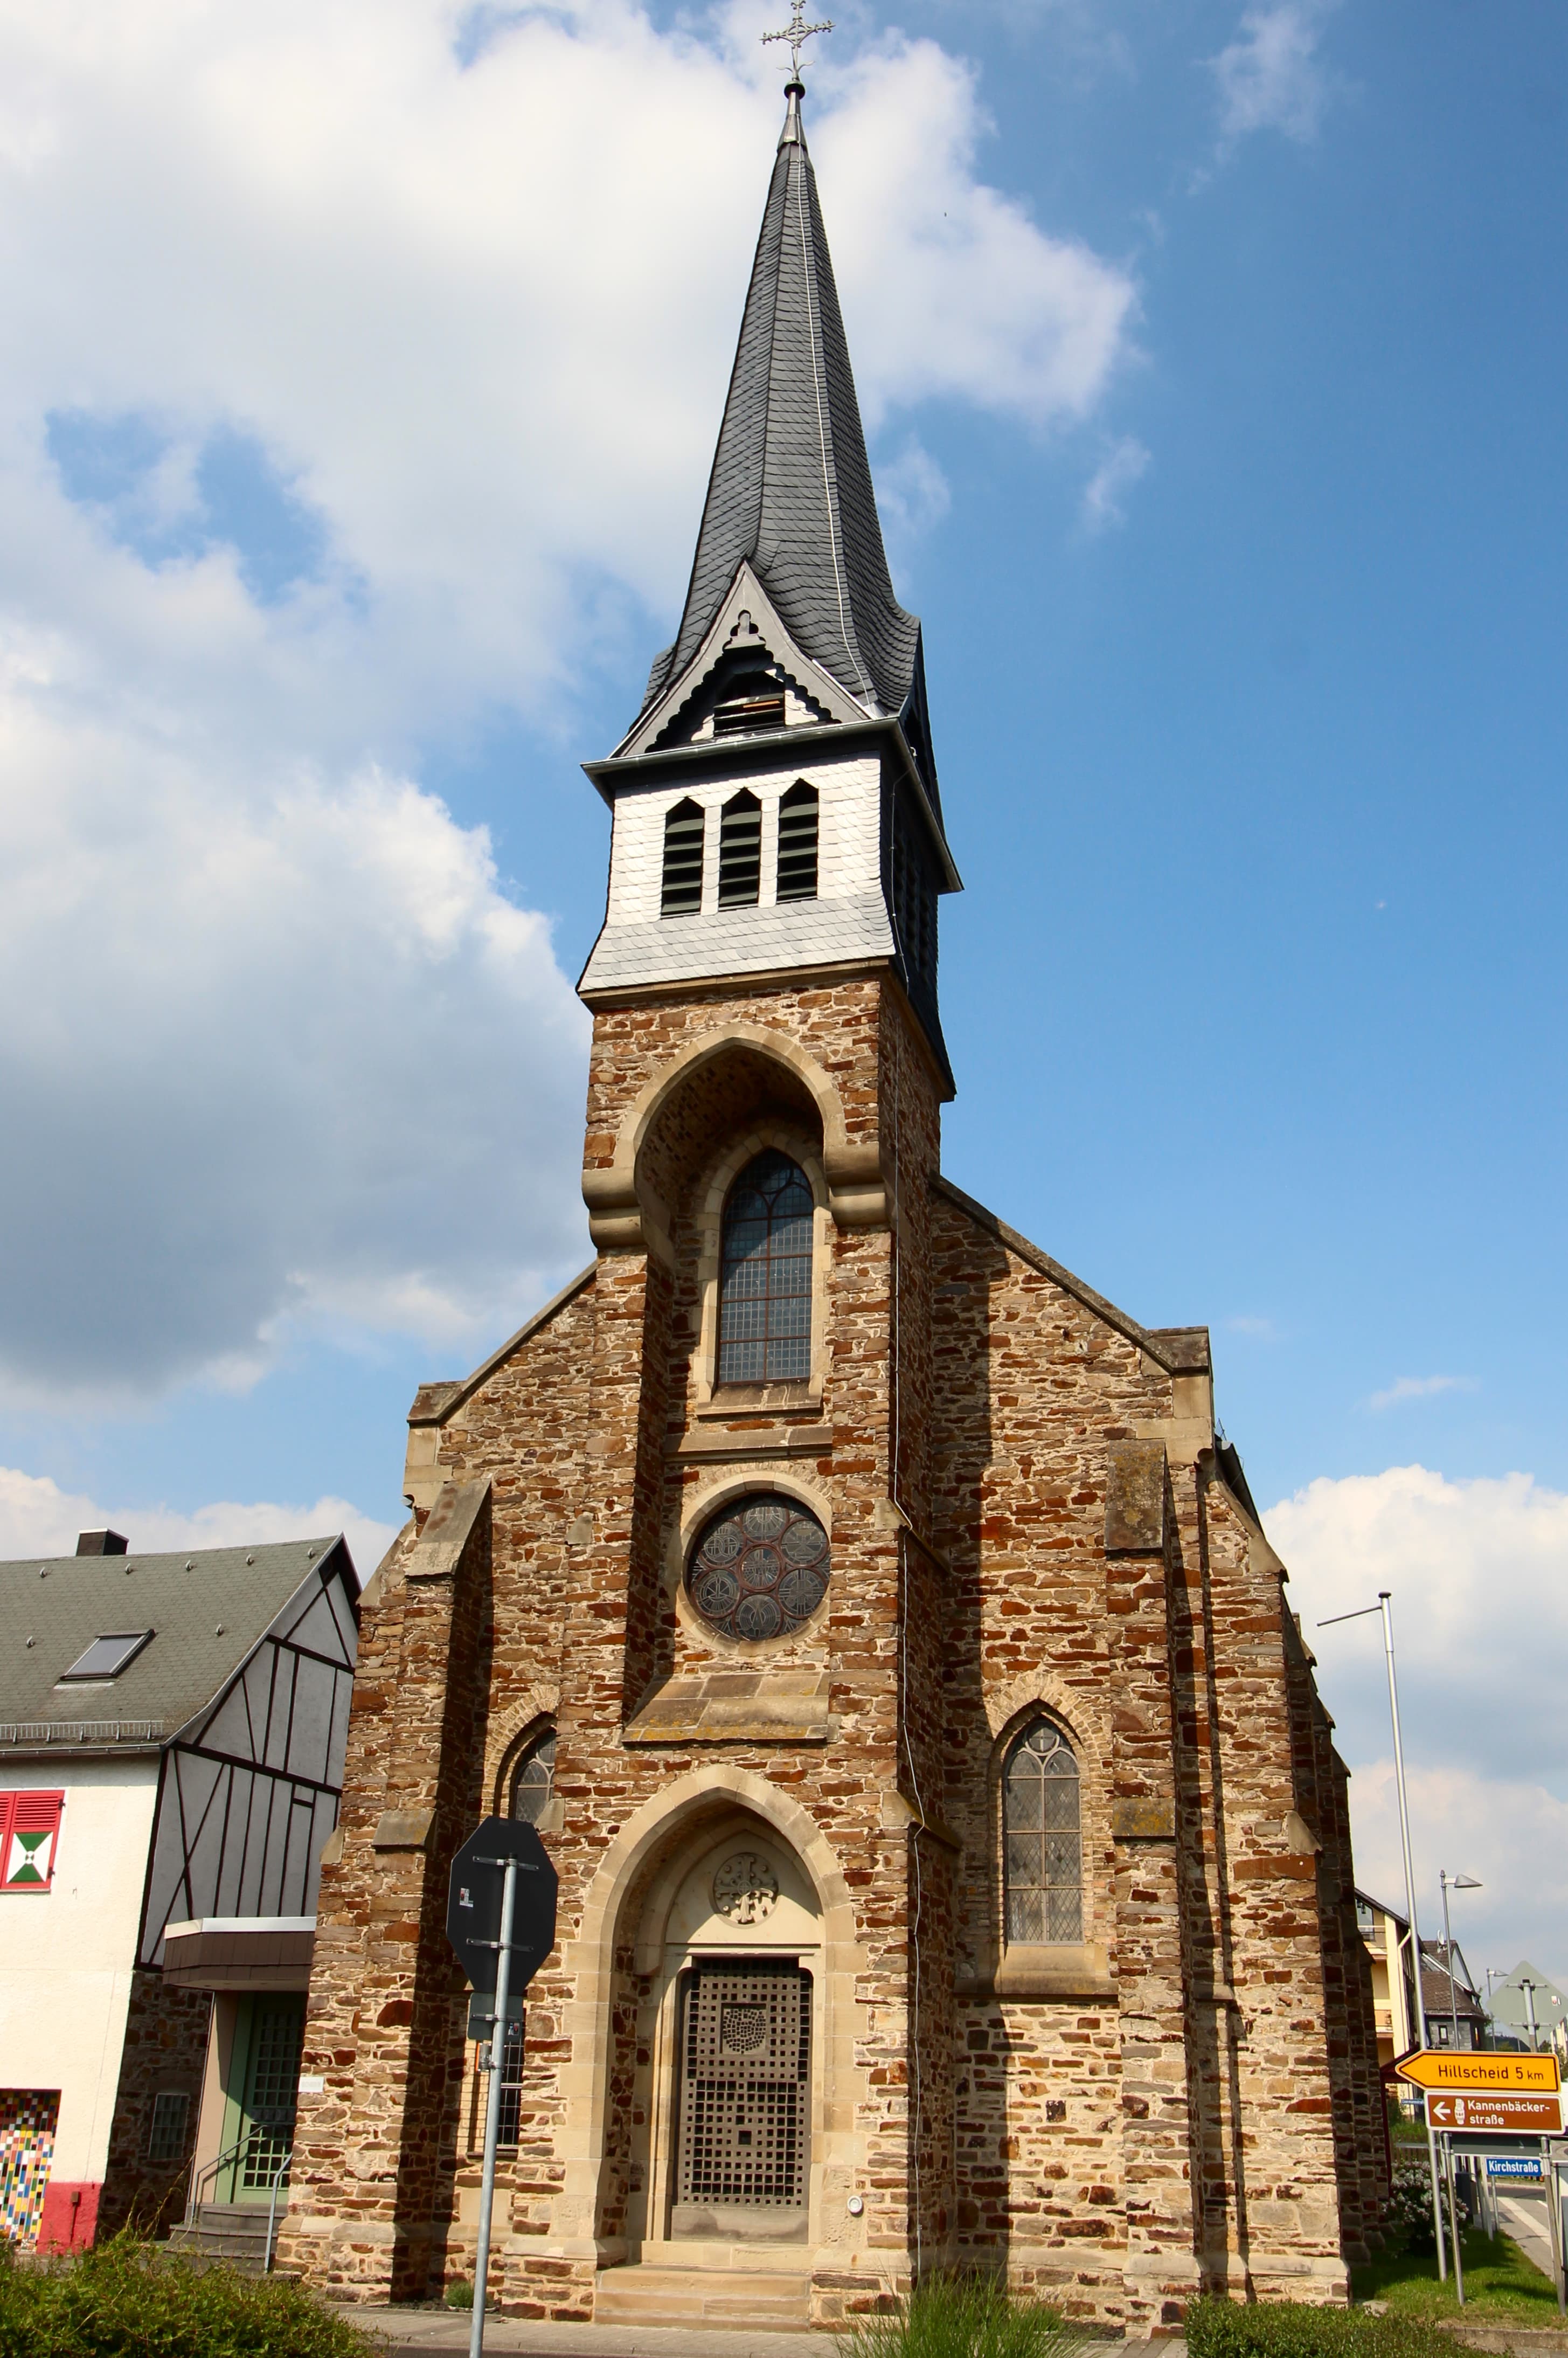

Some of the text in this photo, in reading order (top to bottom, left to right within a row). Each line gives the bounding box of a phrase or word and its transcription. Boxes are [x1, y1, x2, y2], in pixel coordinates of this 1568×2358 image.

[1438, 2065, 1544, 2080] Hillscheid 5 km
[1467, 2100, 1550, 2112] Kannenbäcker-
[1469, 2114, 1504, 2125] straße
[1488, 2160, 1539, 2173] Kirchstraße
